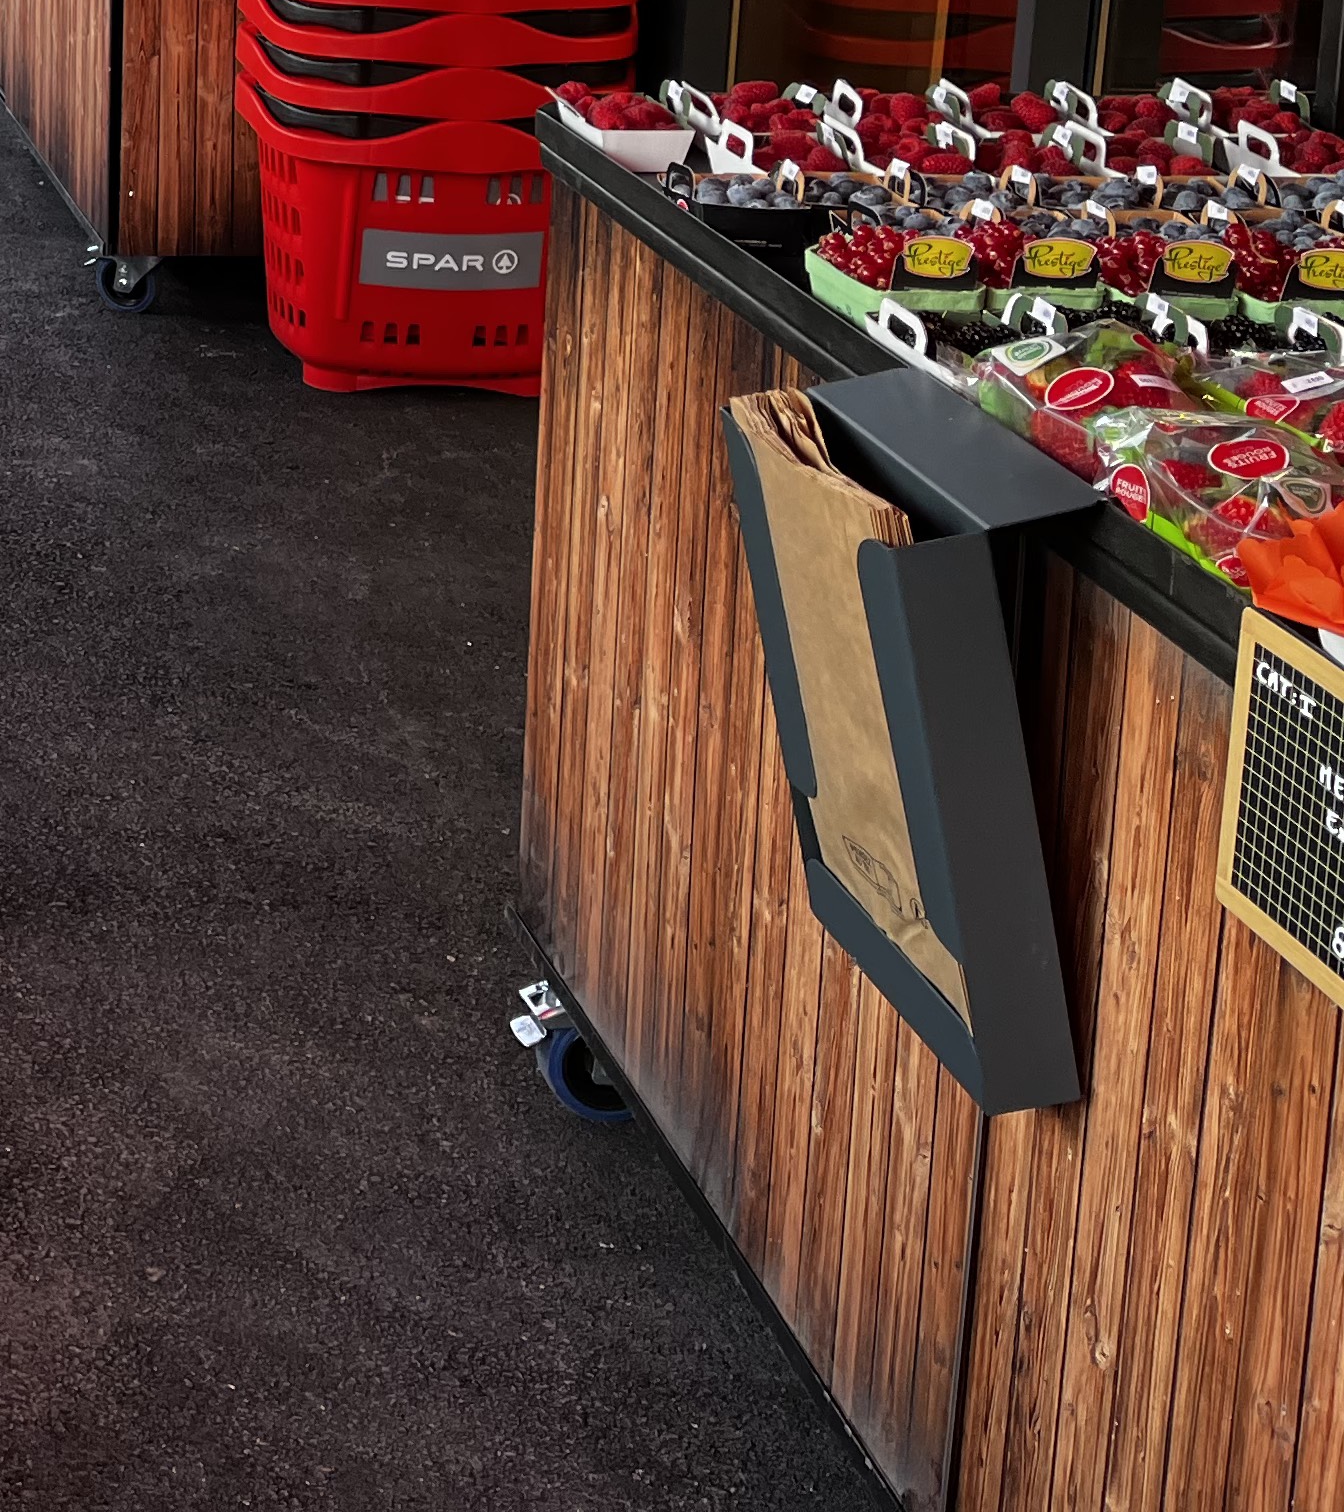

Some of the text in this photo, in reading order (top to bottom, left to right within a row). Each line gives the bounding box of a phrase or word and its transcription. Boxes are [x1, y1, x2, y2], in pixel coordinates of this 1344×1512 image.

[386, 250, 484, 273] SPAR
[905, 243, 970, 277] Prestige
[1025, 245, 1092, 277] Prestige
[1164, 246, 1229, 281] Prestige
[1256, 660, 1317, 720] CAT:I
